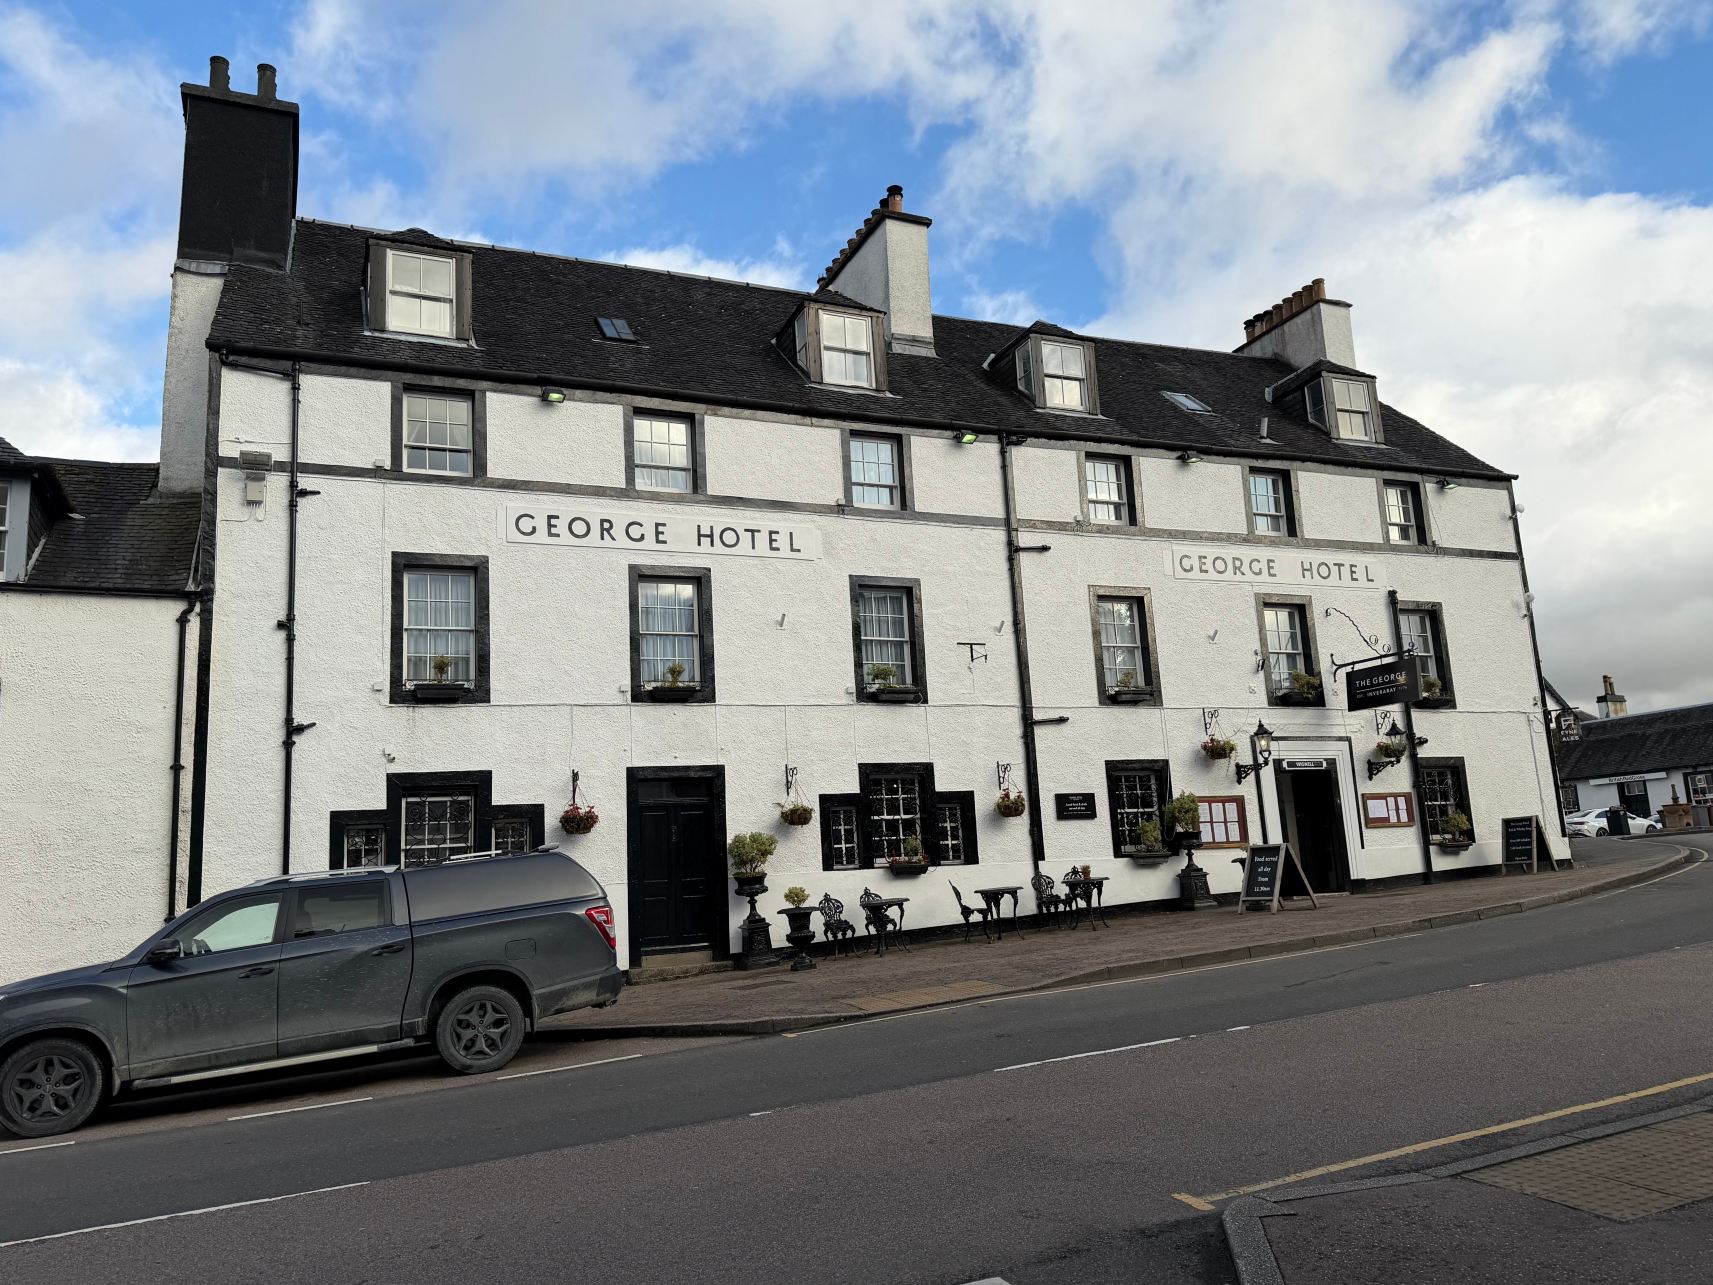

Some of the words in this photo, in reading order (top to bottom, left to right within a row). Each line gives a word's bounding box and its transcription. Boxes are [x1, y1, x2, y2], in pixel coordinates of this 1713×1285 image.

[514, 513, 668, 545] GEORGE
[697, 524, 802, 553] HOTEL
[1179, 554, 1277, 578] GEORGE
[1300, 560, 1375, 583] HOTEL
[1356, 678, 1371, 688] THE
[1372, 671, 1407, 685] GEORGE
